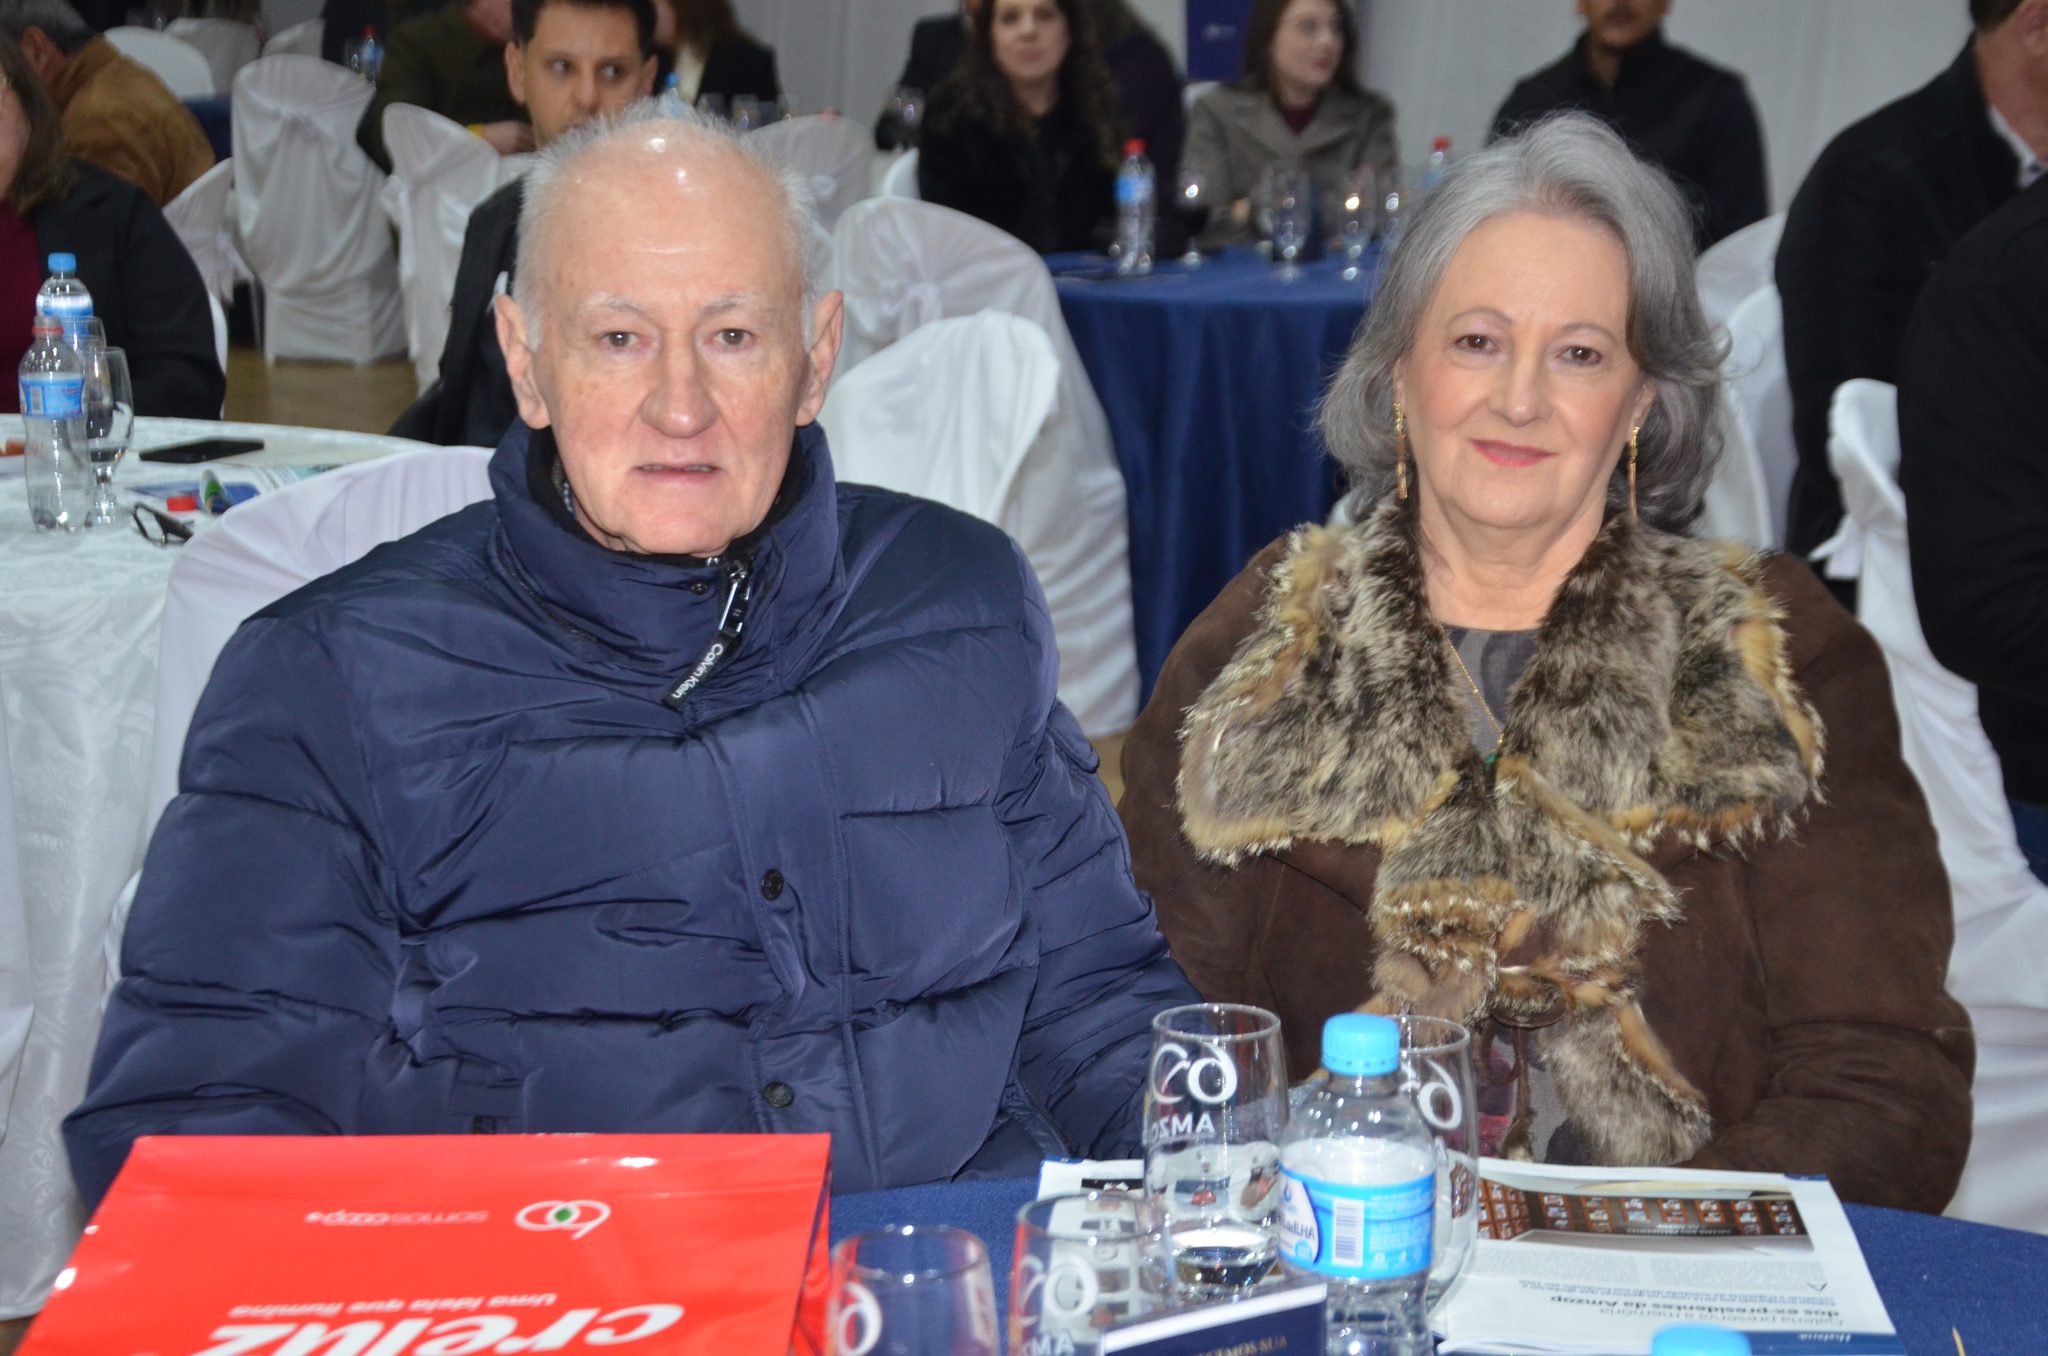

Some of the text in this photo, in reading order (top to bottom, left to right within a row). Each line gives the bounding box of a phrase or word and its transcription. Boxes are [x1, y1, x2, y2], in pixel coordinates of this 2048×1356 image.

[671, 643, 724, 699] Calvin Klein
[228, 1293, 558, 1318] Uma ideia que ilumina
[1623, 1301, 1648, 1309] da
[1651, 1302, 1798, 1316] ex-presidentes
[1804, 1309, 1840, 1317] dos
[193, 1303, 685, 1356] creluz
